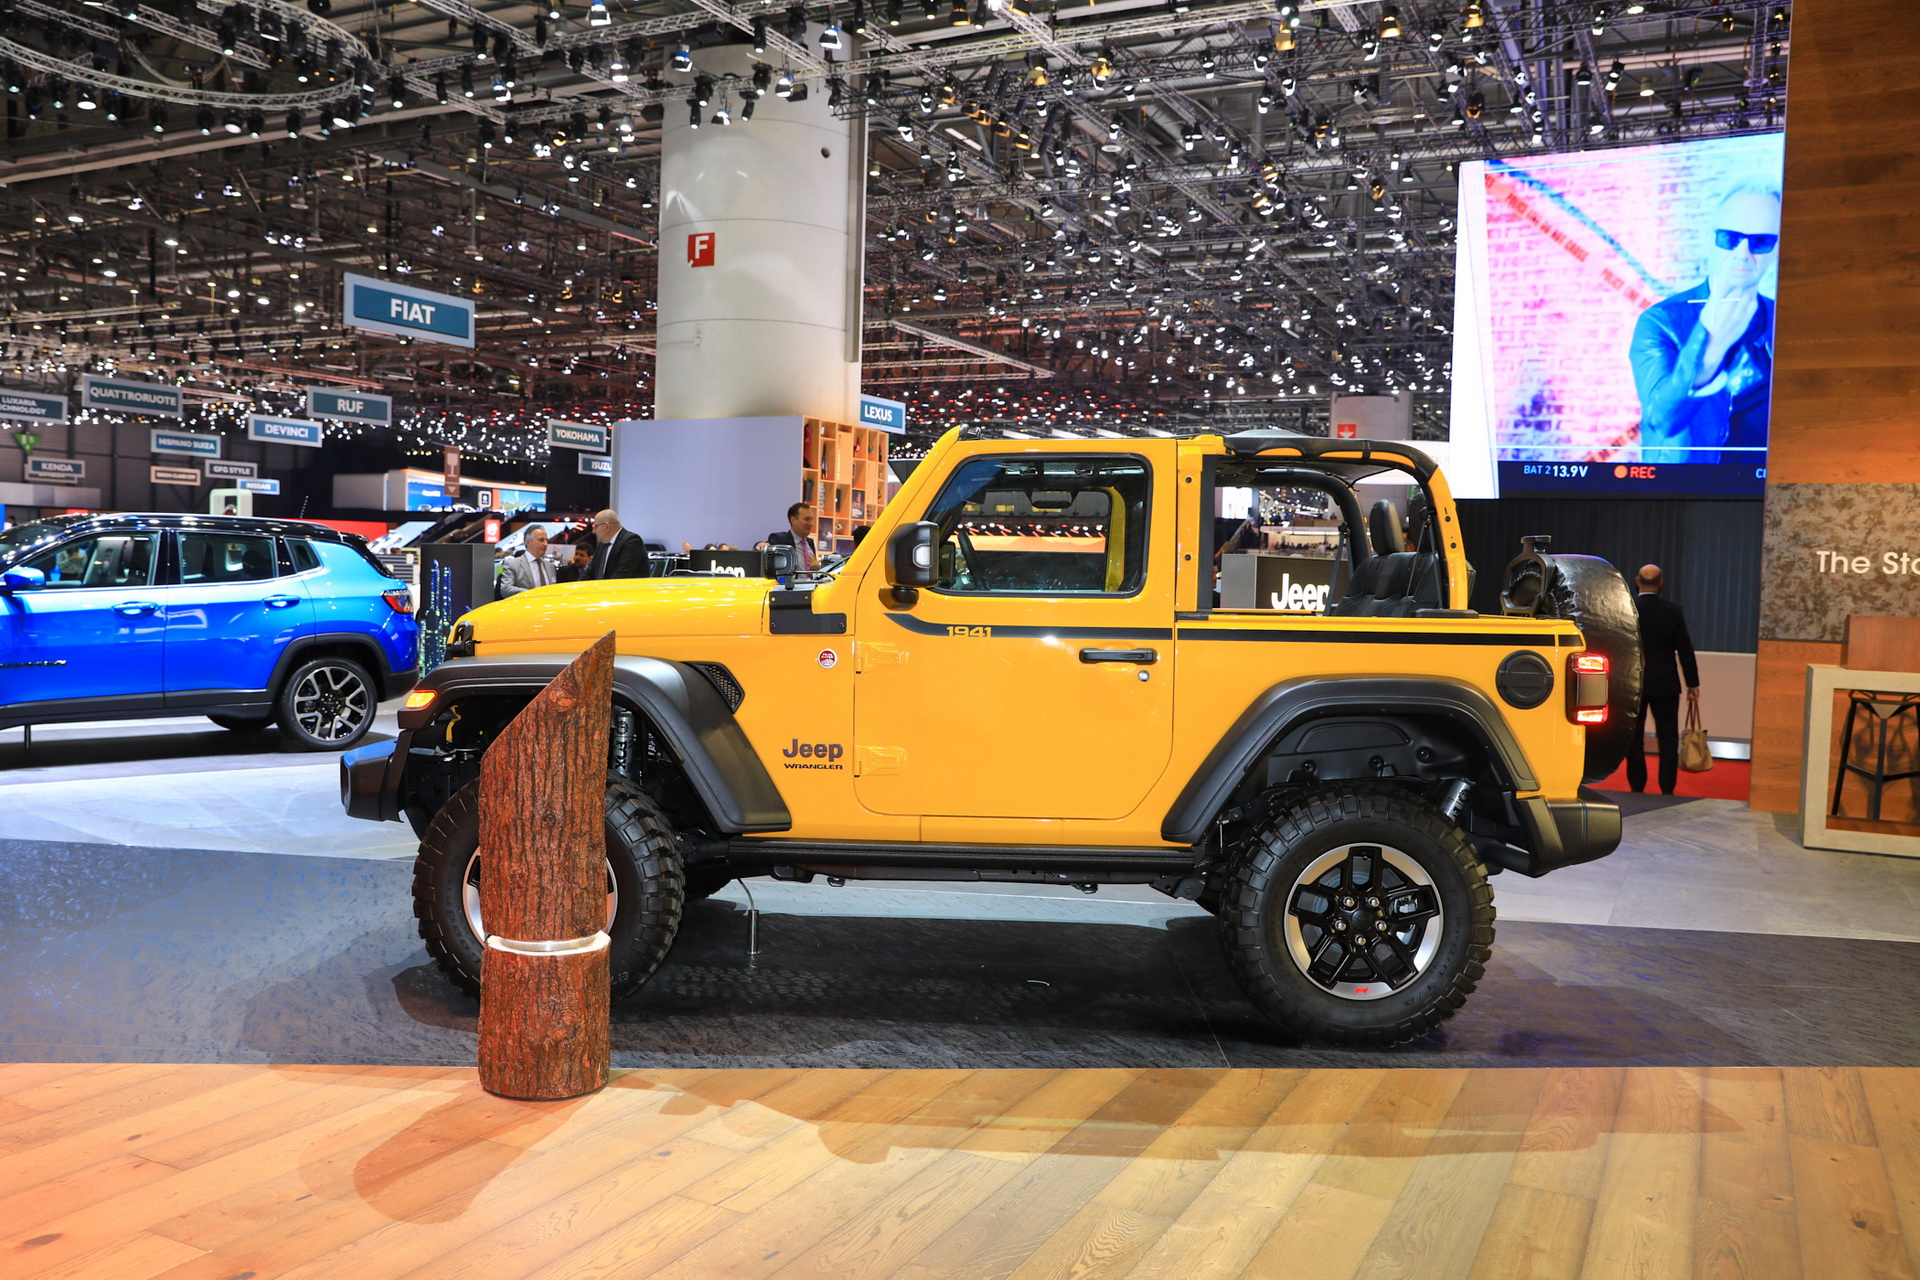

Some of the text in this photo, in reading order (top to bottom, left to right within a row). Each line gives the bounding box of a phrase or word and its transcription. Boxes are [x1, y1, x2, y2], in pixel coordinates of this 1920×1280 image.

[694, 235, 709, 260] F
[391, 298, 435, 325] FIAT
[90, 386, 177, 406] QUATTRORUOTE
[337, 398, 364, 413] RUF
[864, 405, 893, 422] LEXUS
[265, 423, 309, 438] DEVINCI
[555, 429, 600, 443] YOKOHAMA
[158, 437, 215, 450] HISPANO SUIZA
[41, 462, 74, 472] KENDA
[212, 465, 251, 475] GFG STYLE
[1523, 465, 1589, 478] BAT 2 13.9V
[1629, 466, 1657, 479] REC
[245, 482, 272, 490] NISSAN
[1816, 551, 1871, 574] The
[1271, 573, 1330, 611] Jeep
[946, 625, 992, 638] 1941
[615, 740, 628, 771] FOX
[783, 738, 844, 762] Jeep
